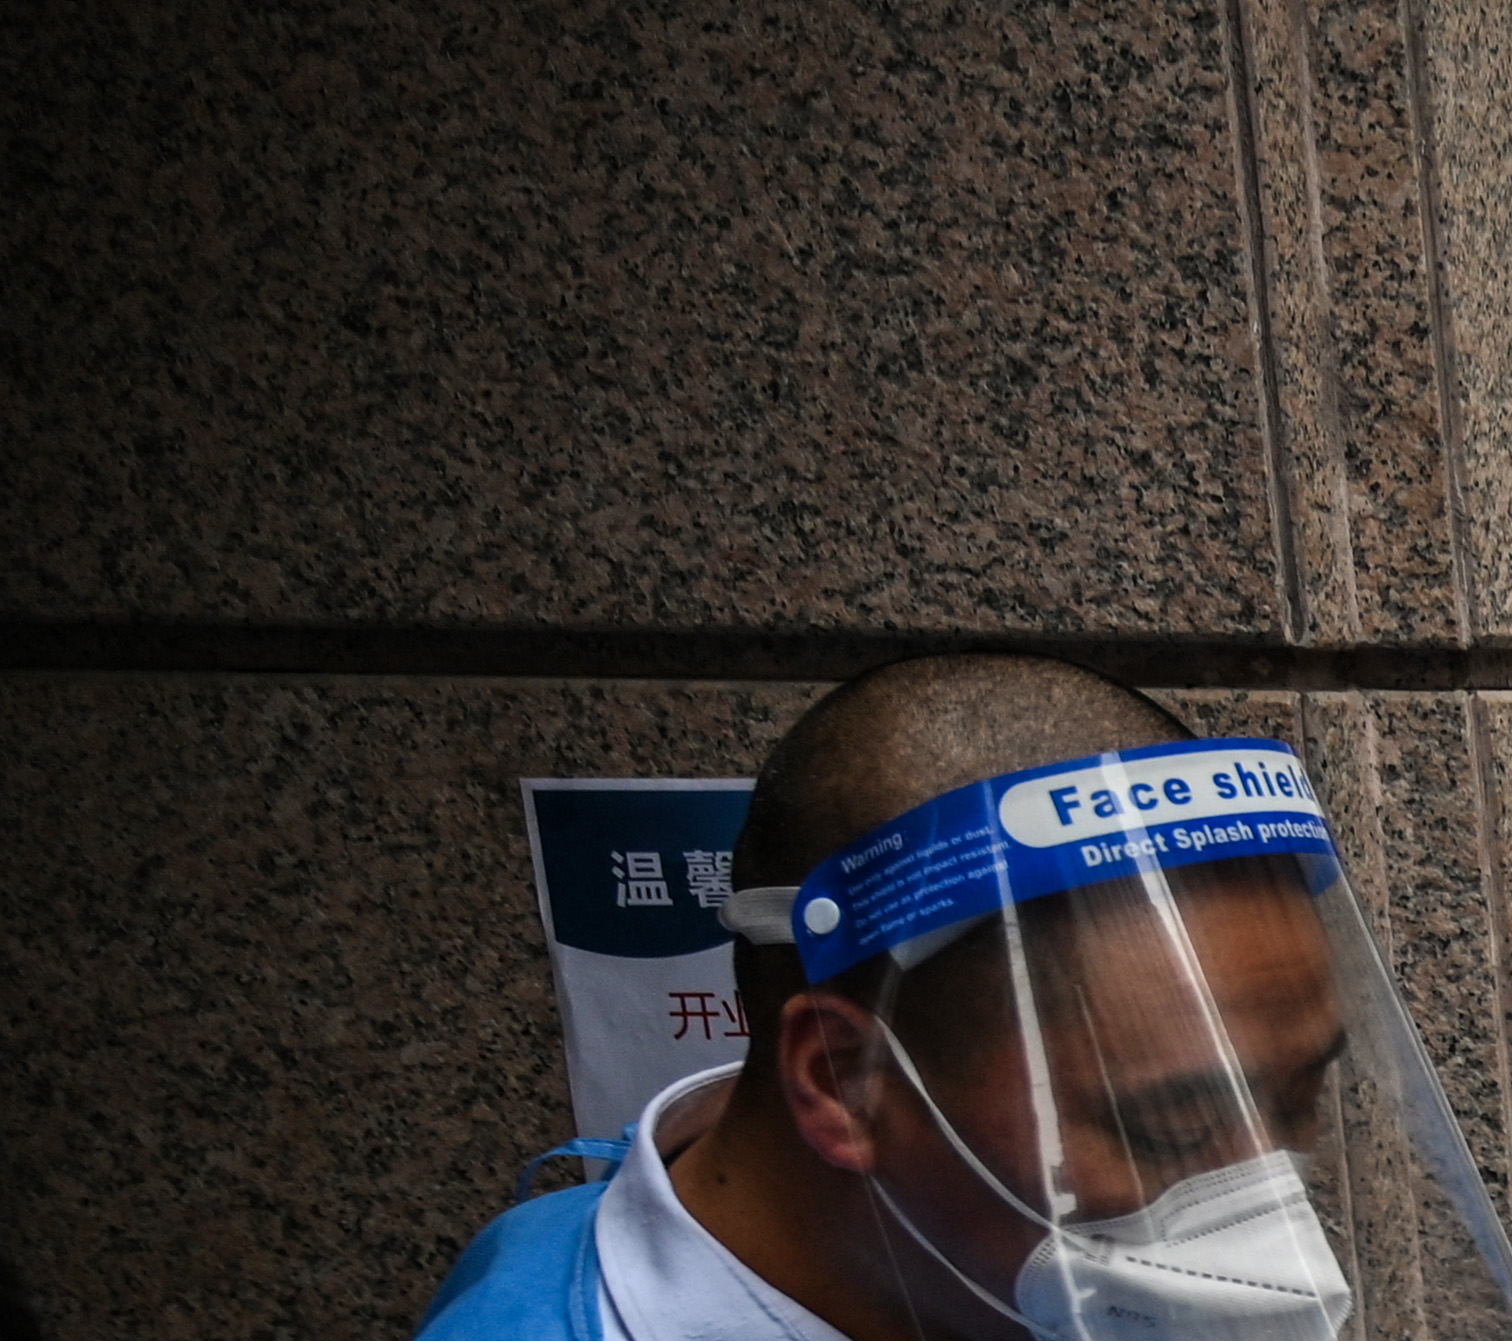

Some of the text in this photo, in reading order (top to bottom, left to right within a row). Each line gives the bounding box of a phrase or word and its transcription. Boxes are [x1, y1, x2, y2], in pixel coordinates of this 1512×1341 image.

[1049, 761, 1314, 826] Face shield
[1081, 832, 1169, 867] Direct
[1173, 820, 1254, 851] Splash
